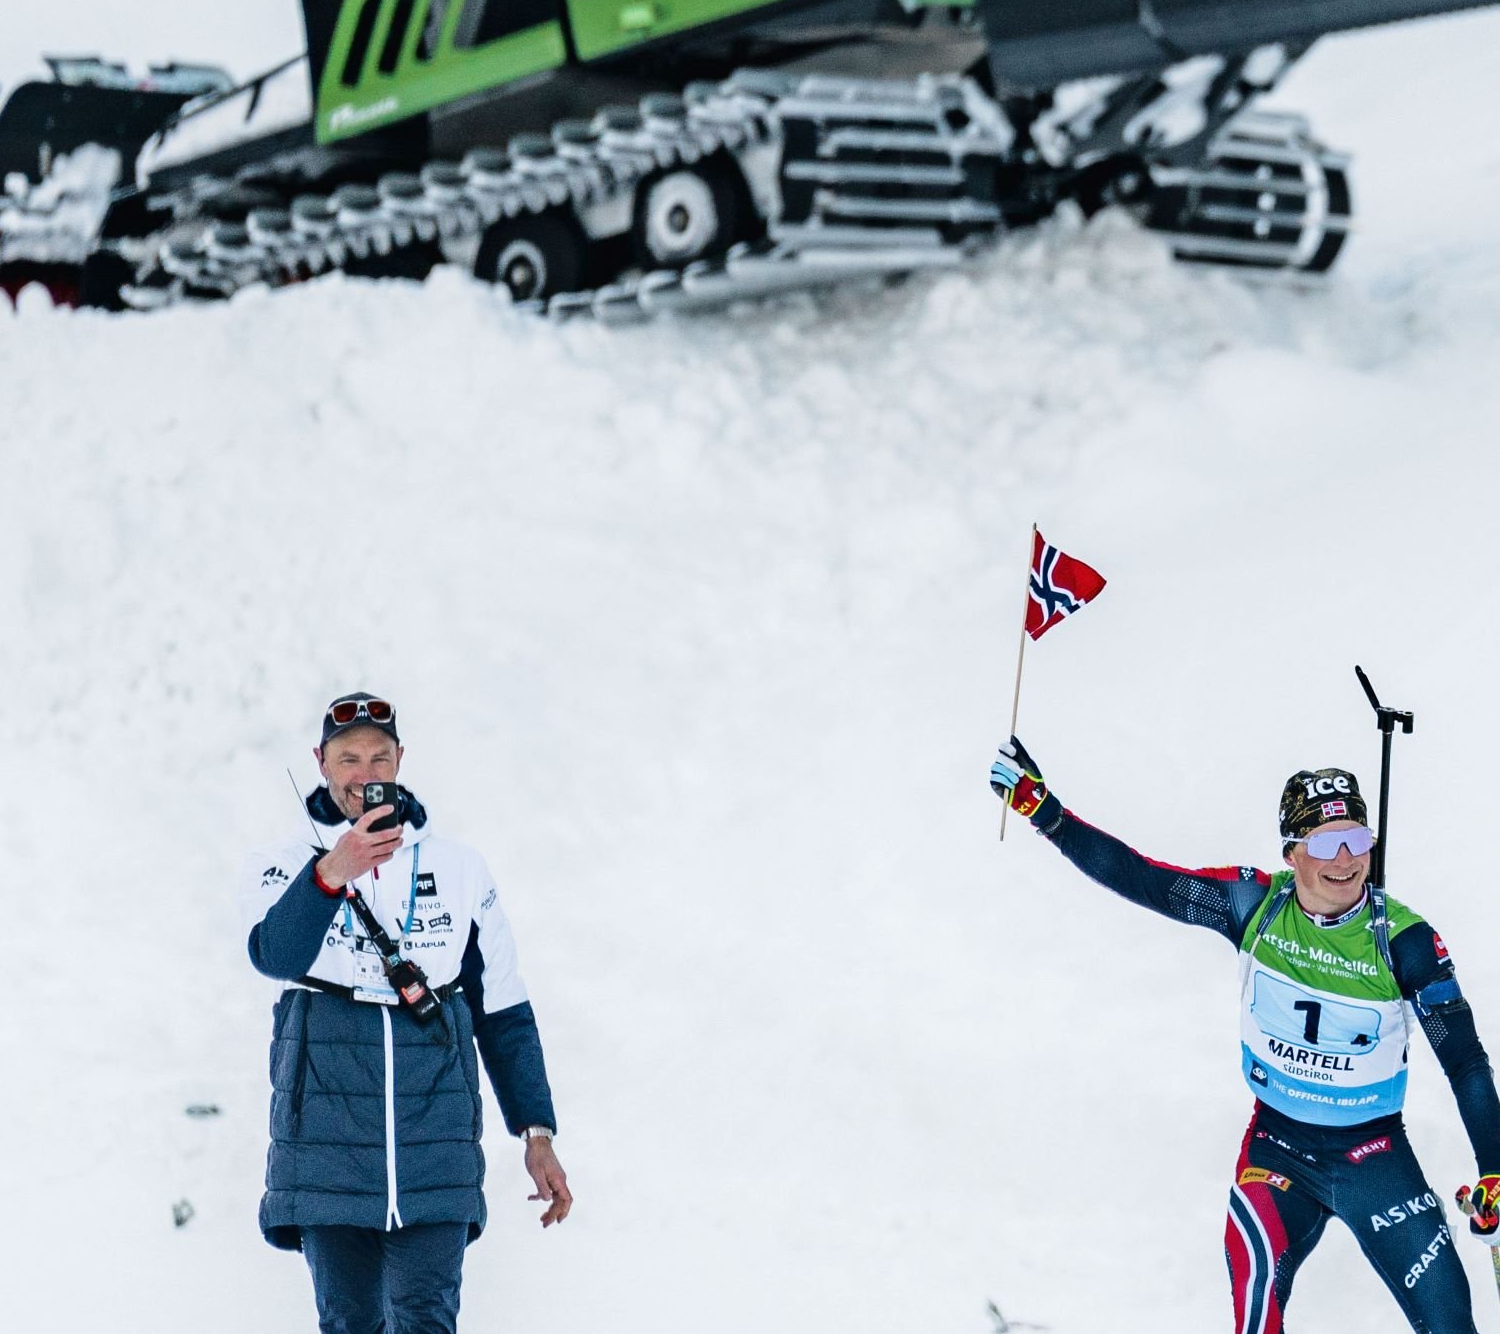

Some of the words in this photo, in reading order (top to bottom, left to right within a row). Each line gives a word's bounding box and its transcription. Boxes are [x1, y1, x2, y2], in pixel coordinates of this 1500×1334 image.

[1303, 776, 1351, 799] ice
[414, 940, 447, 948] LAPUA
[1294, 1000, 1322, 1045] 1
[1351, 1033, 1372, 1047] 4
[1268, 1039, 1355, 1071] MARTELL
[1272, 1080, 1286, 1094] THE
[1287, 1088, 1335, 1105] OFFICIAL
[1337, 1097, 1357, 1106] IBU
[1357, 1094, 1379, 1106] APP
[1351, 1140, 1387, 1160] MENY
[1404, 1231, 1447, 1289] CRAFT
